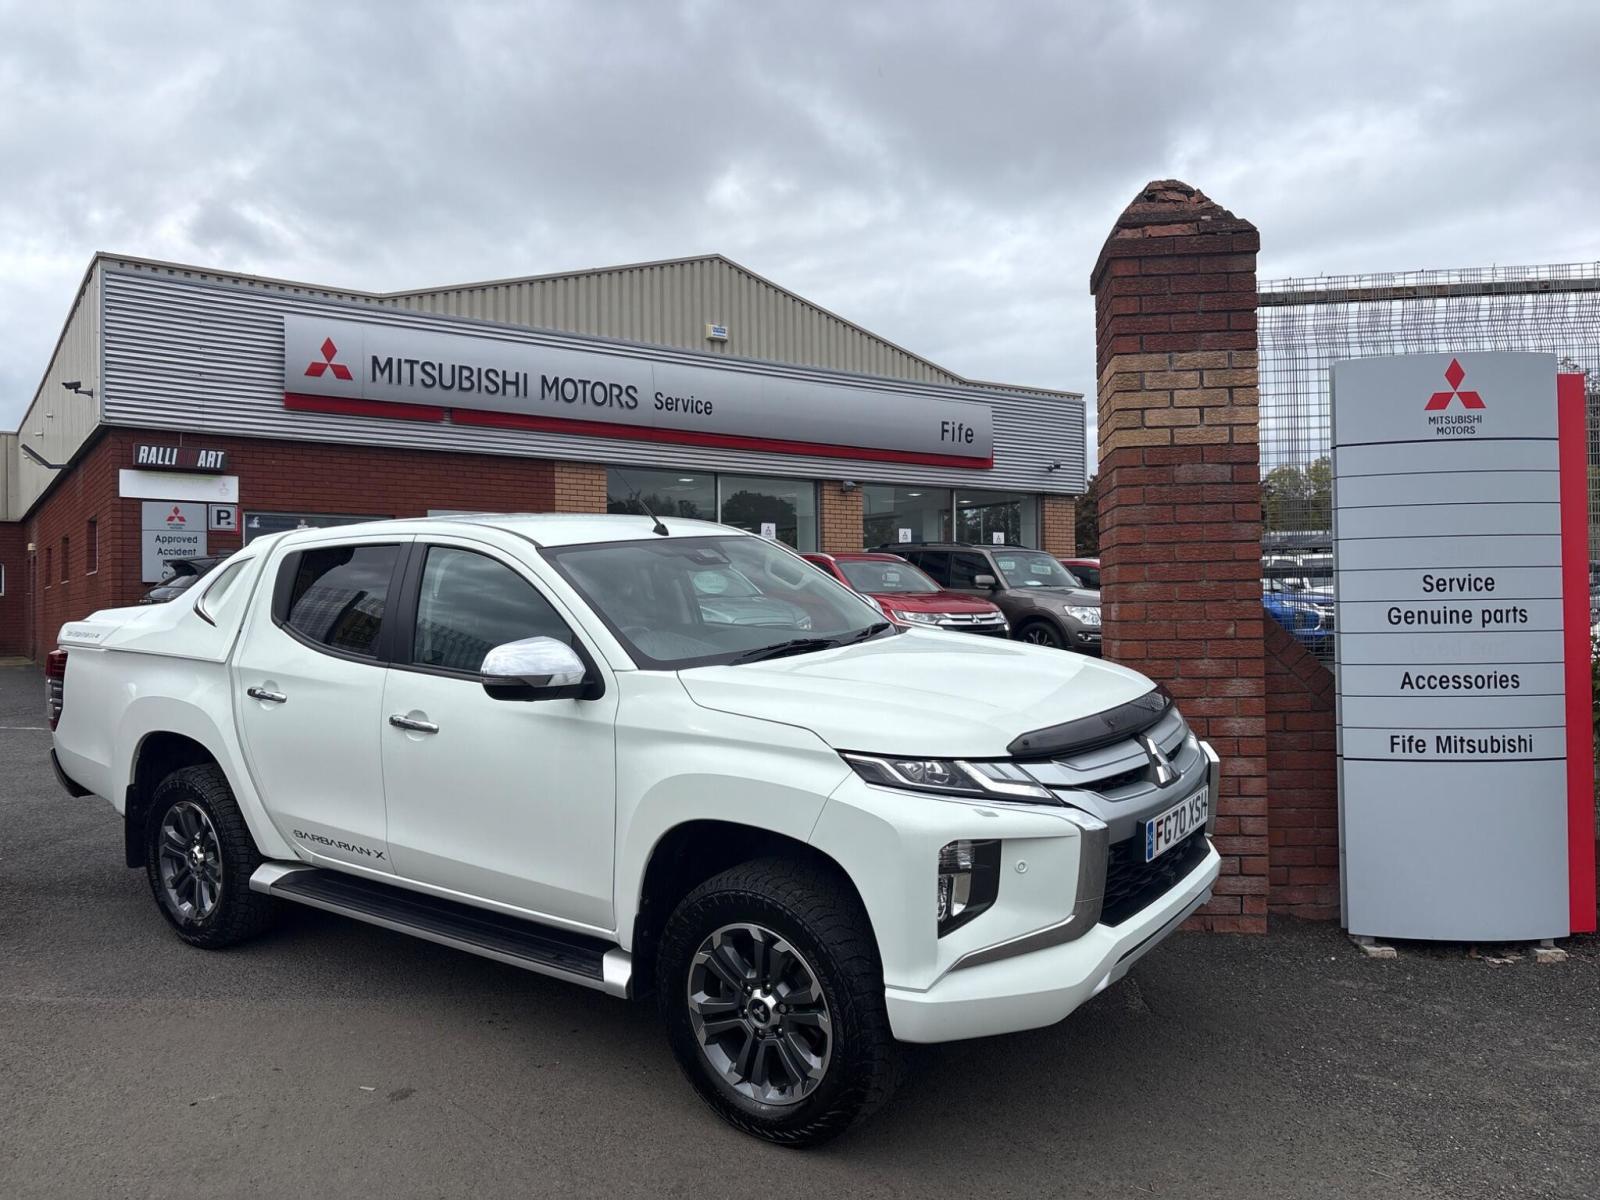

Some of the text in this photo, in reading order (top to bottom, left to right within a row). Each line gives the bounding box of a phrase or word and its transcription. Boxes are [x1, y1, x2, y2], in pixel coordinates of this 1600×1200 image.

[371, 355, 639, 410] MITSUBISHI MOTORS
[654, 391, 713, 415] Service
[1428, 415, 1483, 425] MITSUBISHI
[941, 421, 974, 444] Fife
[1436, 426, 1476, 436] MOTORS
[138, 445, 225, 469] RALLI ART
[216, 509, 231, 526] P
[155, 534, 198, 544] Approved
[157, 547, 197, 556] Accident
[1422, 574, 1496, 593] Service
[1387, 606, 1528, 628] Genuine parts
[1400, 671, 1521, 690] Accessories
[1389, 735, 1533, 754] Fife Mitsubishi
[1156, 789, 1208, 851] FG70 XSH
[293, 829, 386, 861] BARBARIAN X
